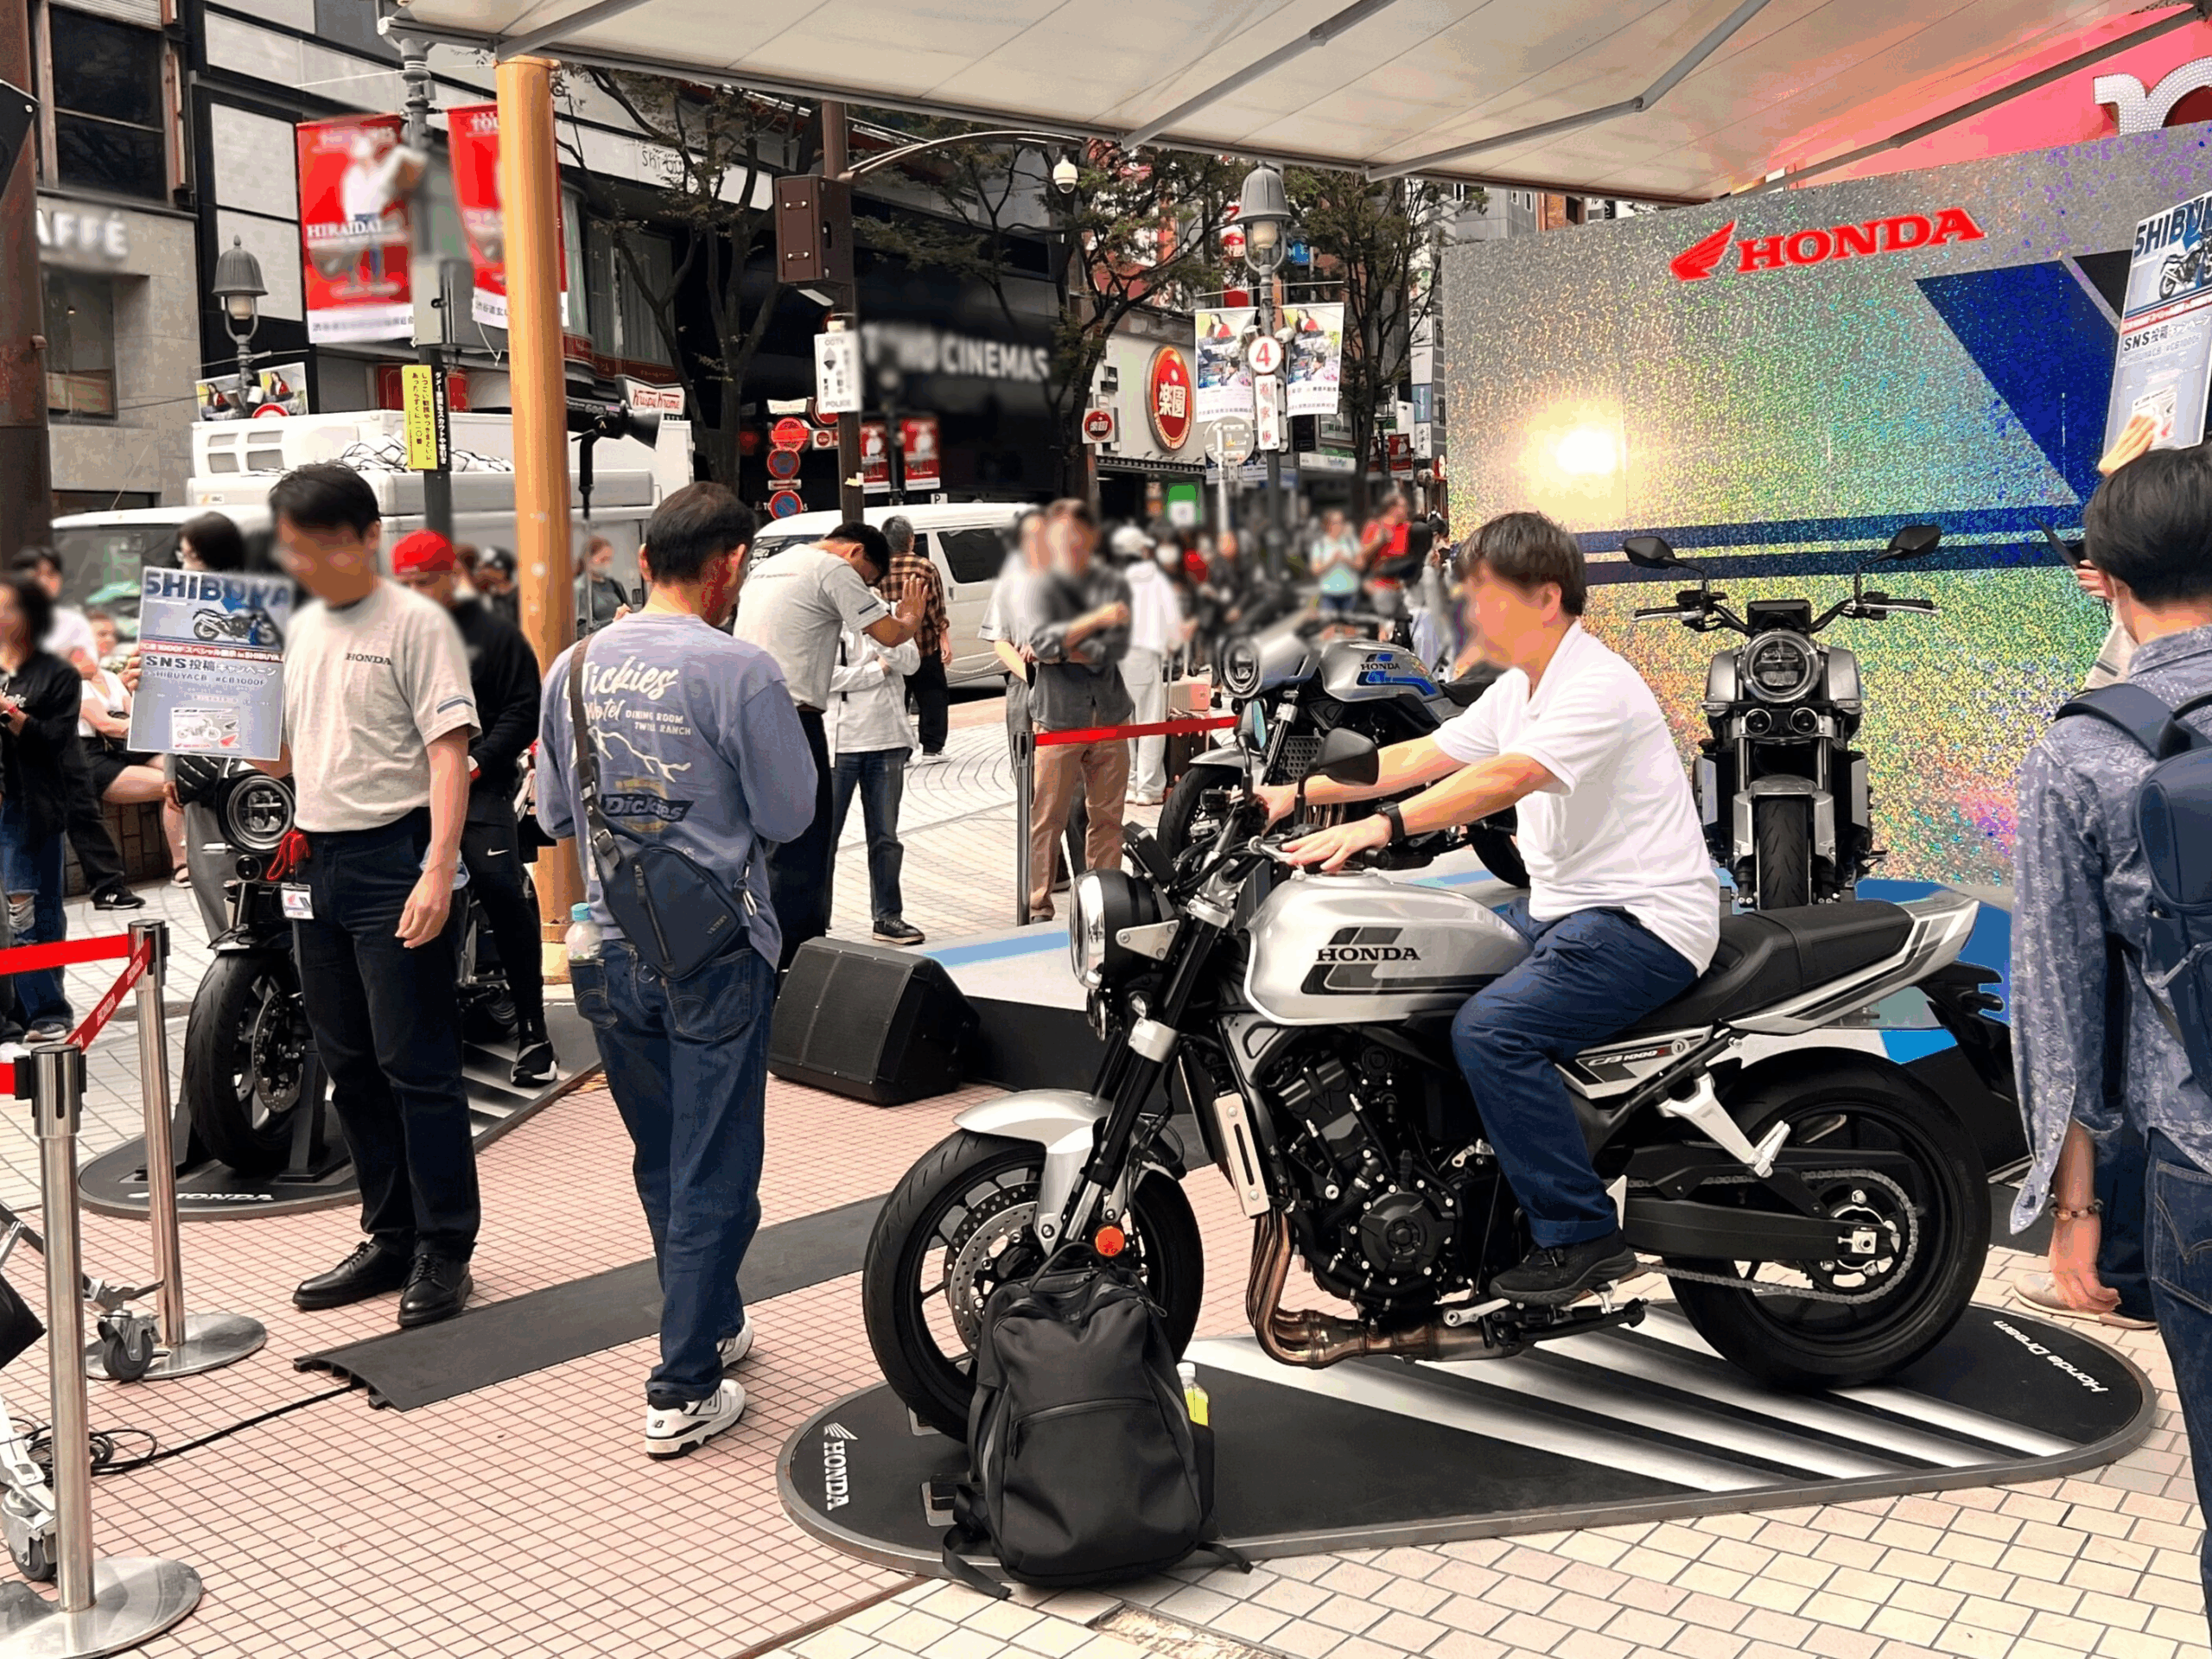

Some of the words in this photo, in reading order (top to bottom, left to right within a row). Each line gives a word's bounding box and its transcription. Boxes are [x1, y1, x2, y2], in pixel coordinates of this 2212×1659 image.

[1736, 207, 1986, 274] HONDA
[942, 334, 1050, 381] CINEMAS
[1255, 343, 1271, 366] 4
[145, 571, 290, 607] SHIBUYA
[346, 652, 391, 665] HONDA
[657, 712, 683, 724] ROOM
[659, 724, 691, 735] RANCH
[606, 797, 684, 820] Dickies
[1316, 947, 1421, 962] HONDA
[1993, 1320, 2050, 1355] Dream
[2047, 1356, 2108, 1392] Honda
[823, 1440, 849, 1510] HONDA
